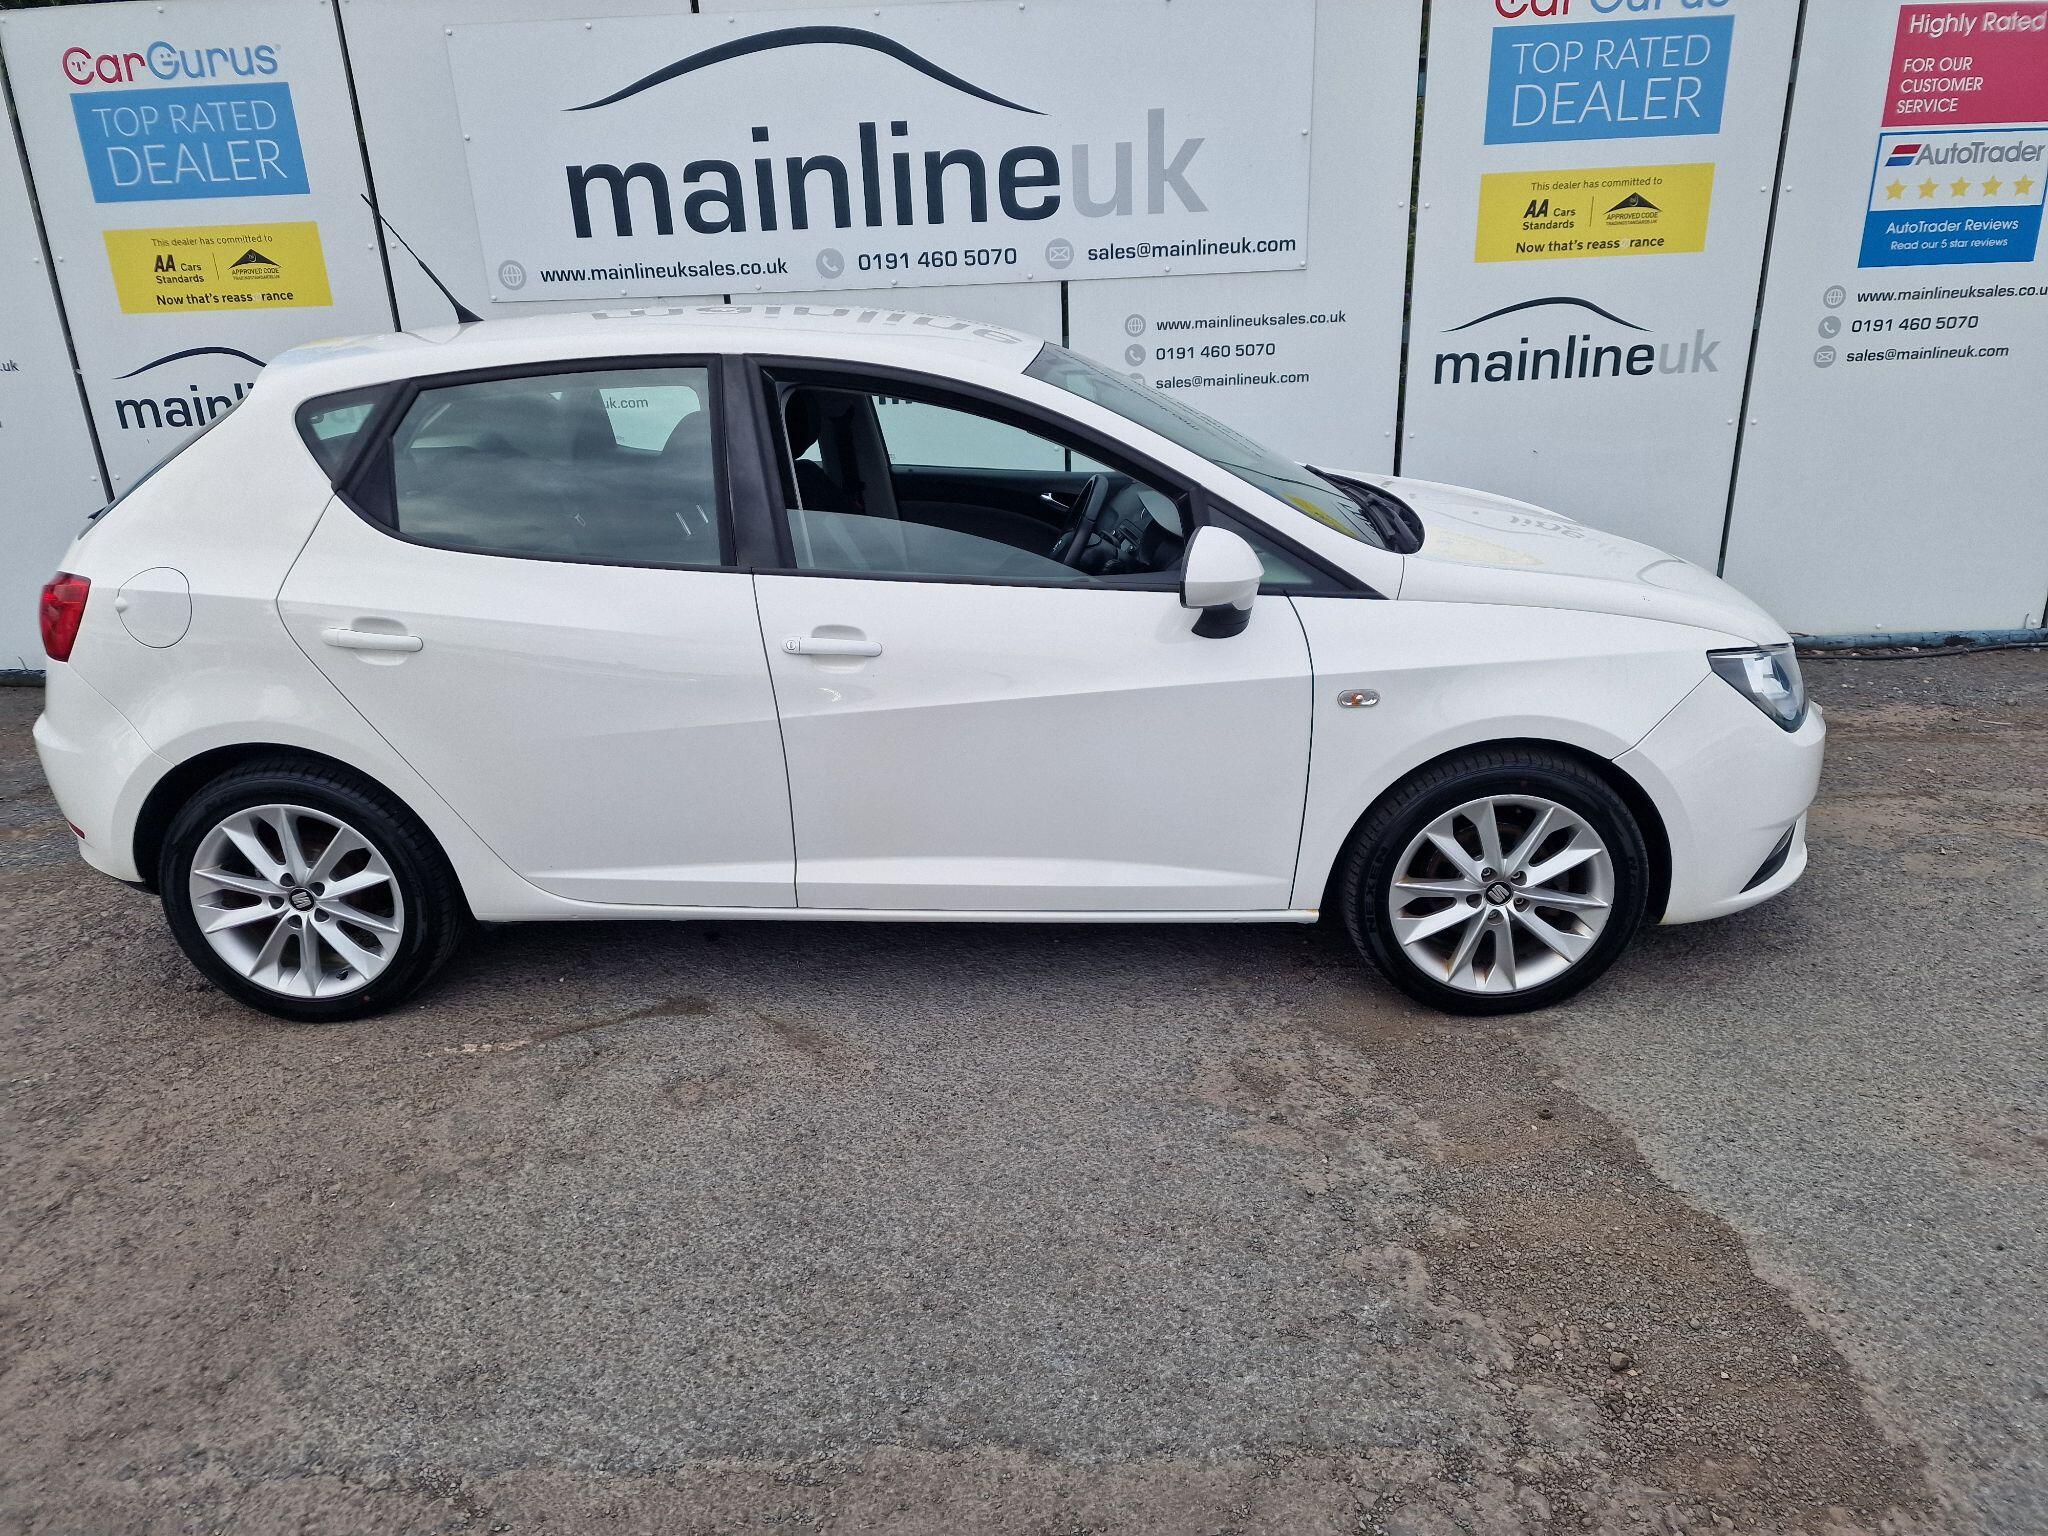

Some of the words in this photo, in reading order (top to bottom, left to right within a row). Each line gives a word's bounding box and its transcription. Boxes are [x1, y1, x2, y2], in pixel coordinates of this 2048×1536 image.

[1909, 13, 1978, 38] Highly
[1982, 10, 2048, 32] Rated
[62, 41, 279, 85] CarGurus
[1512, 41, 1583, 74] TOP
[1595, 34, 1710, 71] RATED
[1903, 57, 1935, 73] FOR
[1939, 56, 1973, 72] OUR
[1900, 77, 1984, 93] CUSTOMER
[1512, 77, 1701, 127] DEALER
[1896, 97, 1959, 114] SERVICE
[92, 105, 158, 138] TOP
[169, 100, 277, 134] RATED
[106, 140, 287, 187] DEALER
[1915, 141, 2045, 167] AutoTrader
[566, 108, 1209, 238] mainlineuk
[1531, 182, 1550, 191] This
[1552, 181, 1581, 190] dealer
[1583, 179, 1600, 188] has
[1601, 177, 1651, 188] committed
[1653, 177, 1663, 186] to
[1523, 199, 1549, 218] AA
[1553, 208, 1576, 217] Cars
[1606, 212, 1641, 221] APPROVED
[1641, 211, 1659, 219] CODE
[1522, 220, 1575, 231] Standards
[1886, 220, 1961, 235] AutoTrader
[1965, 218, 2019, 232] Reviews
[151, 238, 170, 247] This
[172, 237, 197, 247] dealer
[200, 237, 215, 246] has
[216, 235, 262, 244] committed
[263, 234, 273, 243] to
[1087, 236, 1297, 261] sales@mainlineuk.com
[1516, 241, 1546, 254] Now
[1548, 239, 1584, 252] that's
[1586, 237, 1665, 250] reassrance
[1890, 240, 1919, 250] Read
[1921, 240, 1938, 250] our
[1941, 239, 1948, 249] 5
[1950, 239, 1968, 249] star
[1970, 237, 2009, 248] reviews
[154, 254, 176, 273] AA
[180, 262, 202, 272] Cars
[858, 252, 909, 272] 0191
[917, 248, 959, 269] 460
[963, 247, 1017, 267] 5070
[156, 274, 204, 284] Standards
[540, 258, 788, 283] www.mainlineuksales.co.uk
[156, 294, 184, 306] Now
[186, 293, 220, 305] that's
[222, 292, 294, 303] reassrance
[1156, 310, 1346, 332] www.mainlineuksales.co.uk
[1851, 319, 1893, 333] 0191
[1898, 317, 1932, 331] 460
[1935, 315, 1979, 330] 5070
[1156, 345, 1194, 361] 0191
[1200, 344, 1231, 359] 460
[1235, 342, 1276, 358] 5070
[1434, 329, 1721, 385] mainlineuk
[1845, 345, 2010, 362] sales@mainlineuk.com
[1156, 370, 1310, 390] sales@mainlineuk.com
